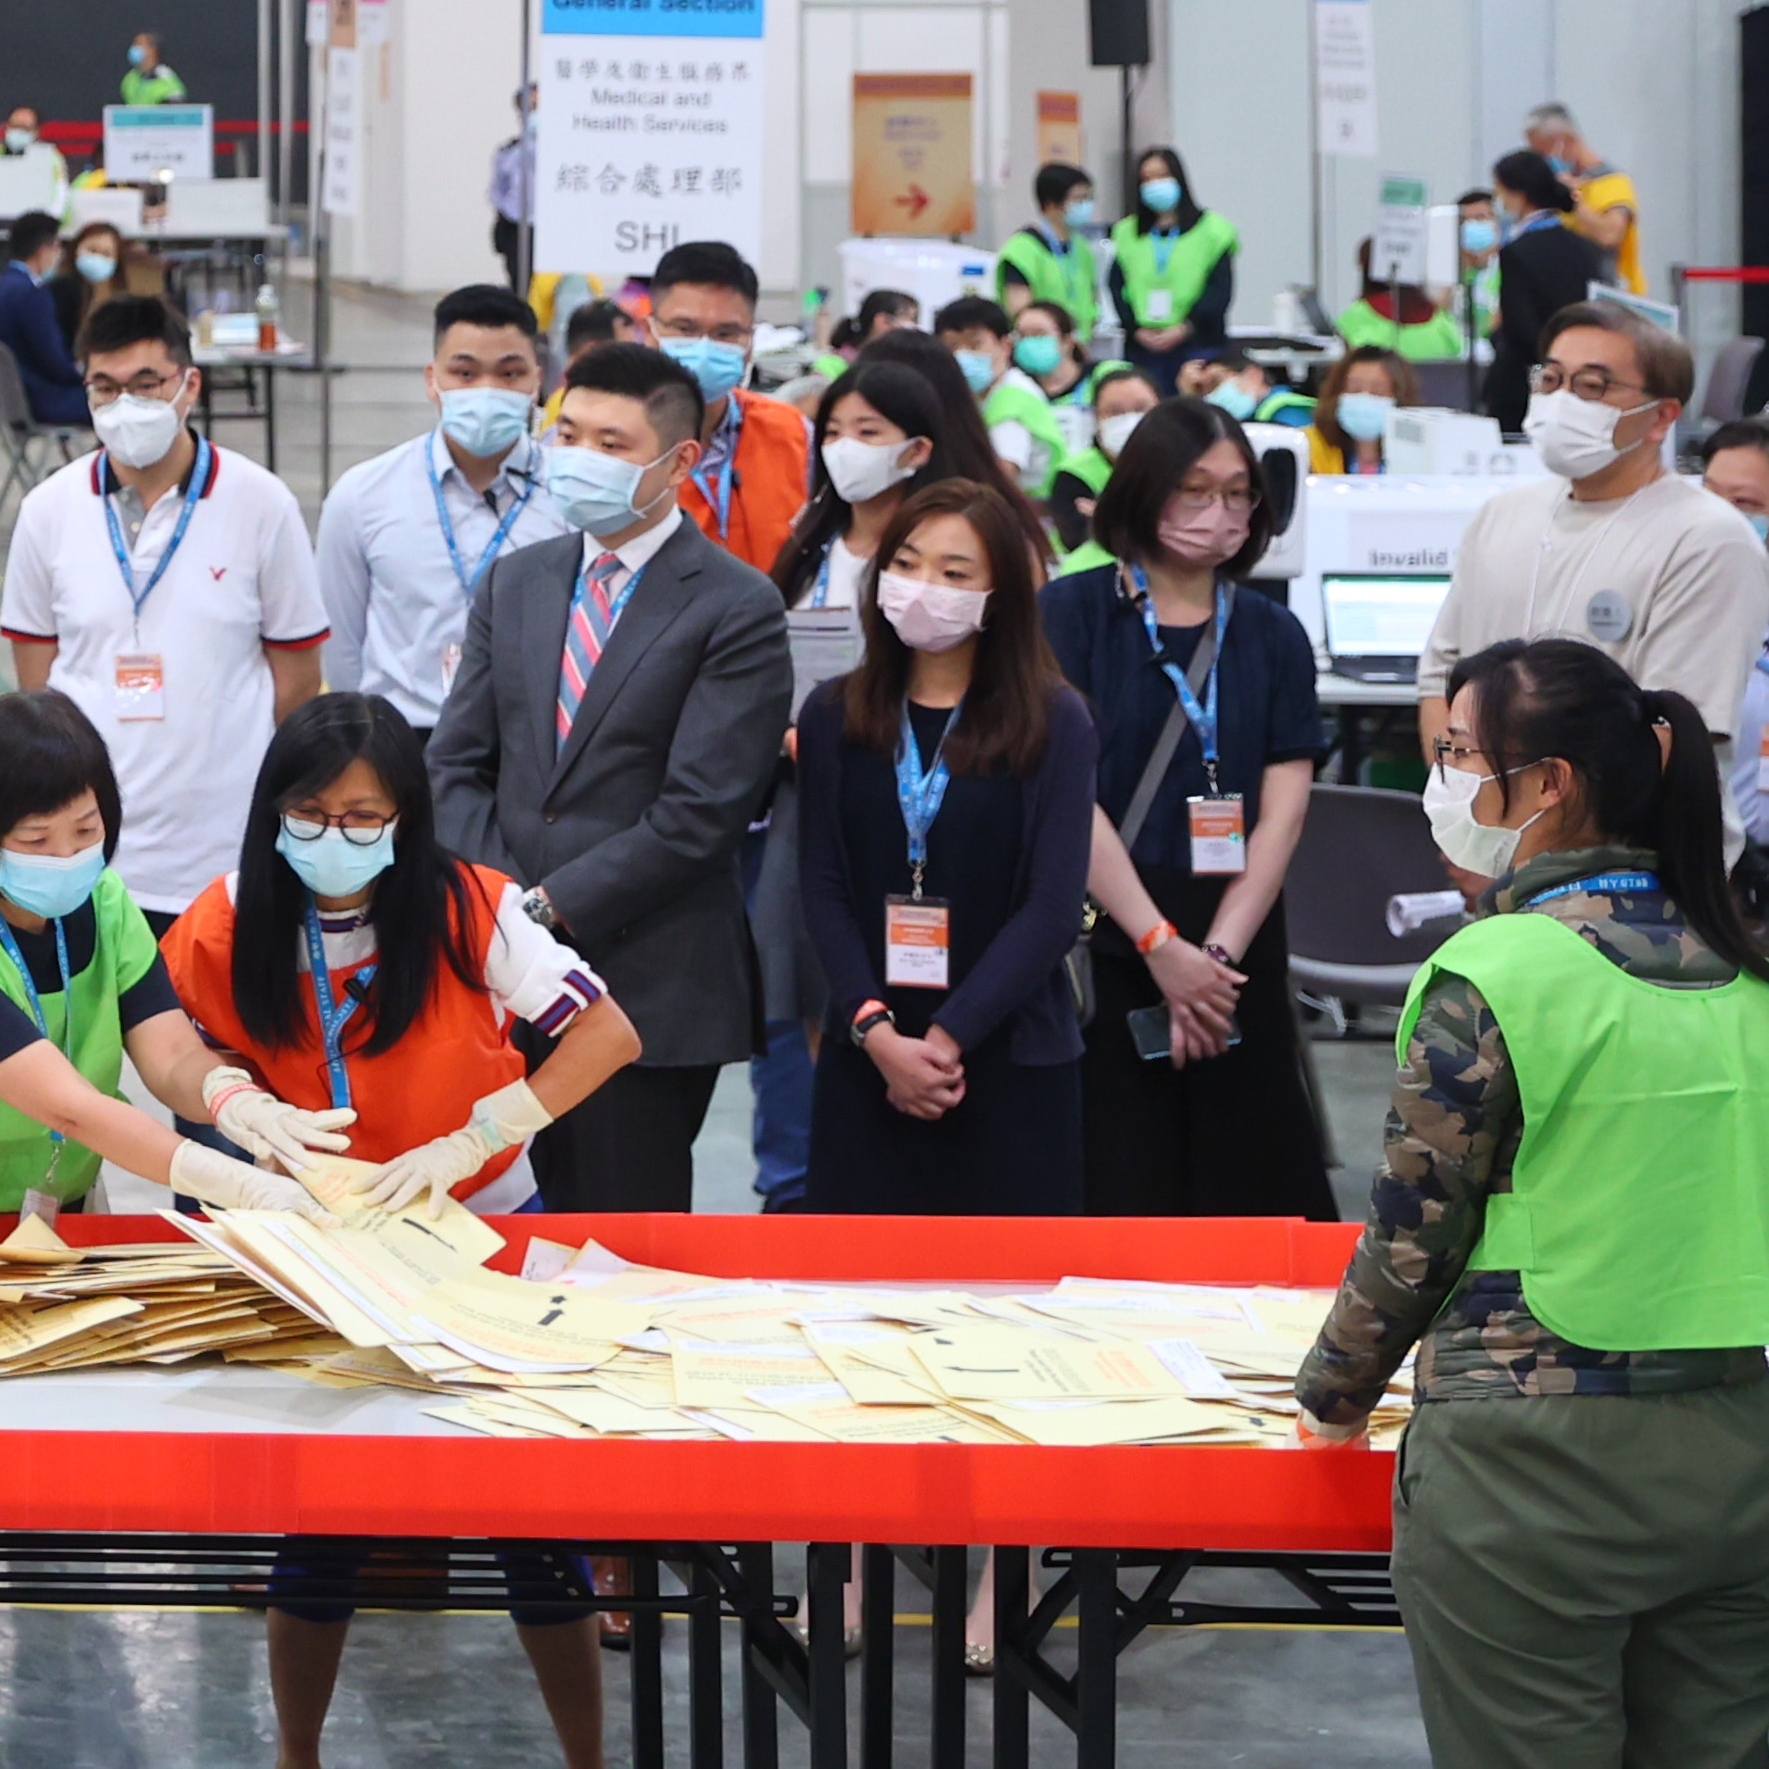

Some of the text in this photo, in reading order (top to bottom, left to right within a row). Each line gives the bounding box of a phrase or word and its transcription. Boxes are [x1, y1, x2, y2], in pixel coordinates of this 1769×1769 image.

[590, 88, 712, 107] Medical and
[572, 114, 729, 134] Health Services
[555, 163, 744, 199] 綜合處理部
[1368, 549, 1448, 568] Invalid
